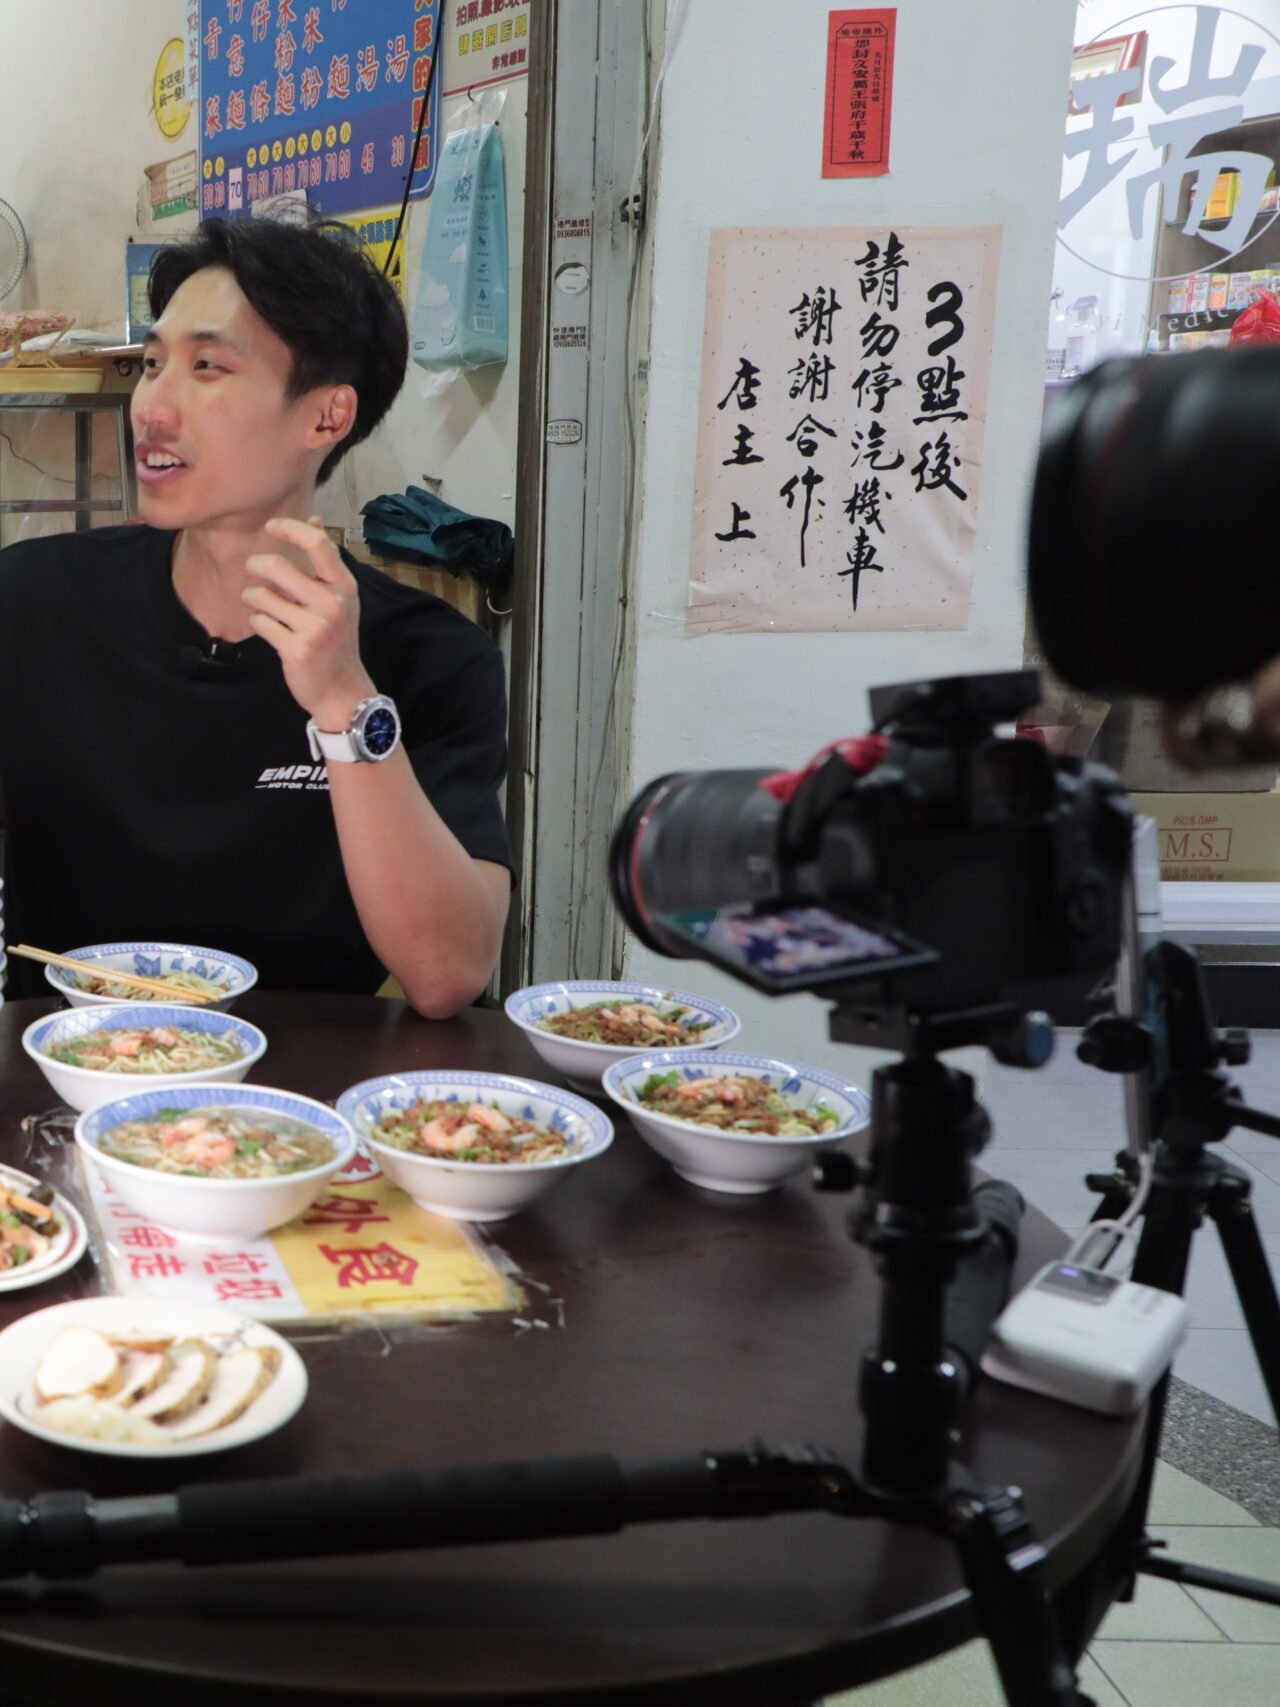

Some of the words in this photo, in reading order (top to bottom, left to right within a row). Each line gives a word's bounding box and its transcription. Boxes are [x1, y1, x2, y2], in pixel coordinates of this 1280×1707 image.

[356, 45, 379, 92] 湯
[385, 35, 410, 83] 湯
[1057, 5, 1275, 253] 瑞
[231, 181, 241, 199] 70
[325, 152, 337, 182] 70
[338, 149, 350, 179] 60
[361, 143, 374, 174] 45
[391, 135, 405, 167] 30
[715, 357, 765, 541] 店主上
[780, 285, 843, 568] 謝謝合作
[837, 232, 910, 612] 請勿停汽機車
[911, 281, 968, 501] 3點後
[1197, 816, 1218, 826] GMP
